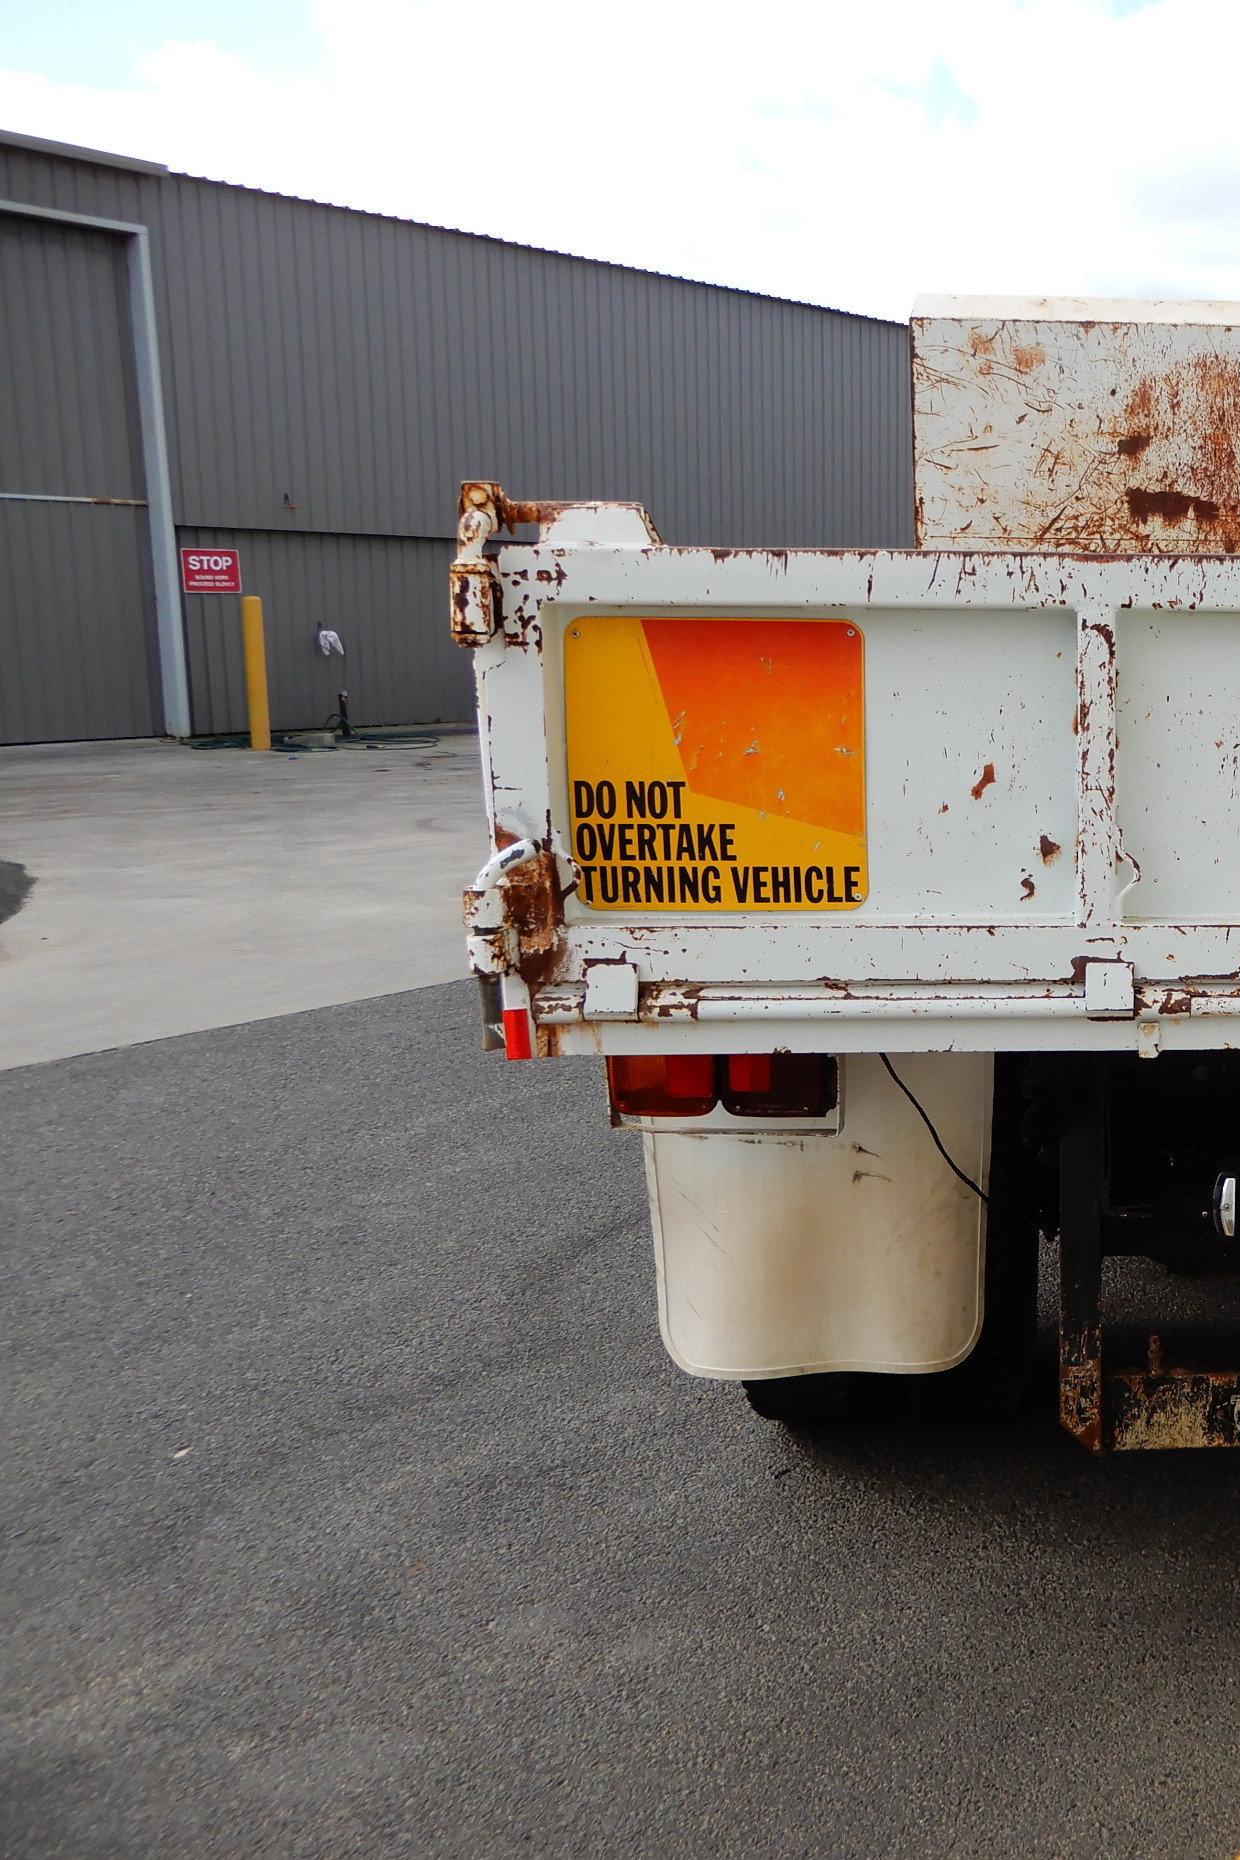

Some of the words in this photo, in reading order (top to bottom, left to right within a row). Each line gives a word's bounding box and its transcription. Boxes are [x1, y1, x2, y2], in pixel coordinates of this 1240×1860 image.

[188, 555, 233, 571] STOP
[573, 780, 617, 819] DO
[625, 780, 686, 819] NOT
[575, 823, 738, 862] OVERTAKE
[581, 866, 721, 904] TURNING
[730, 866, 862, 904] VEHICLE
